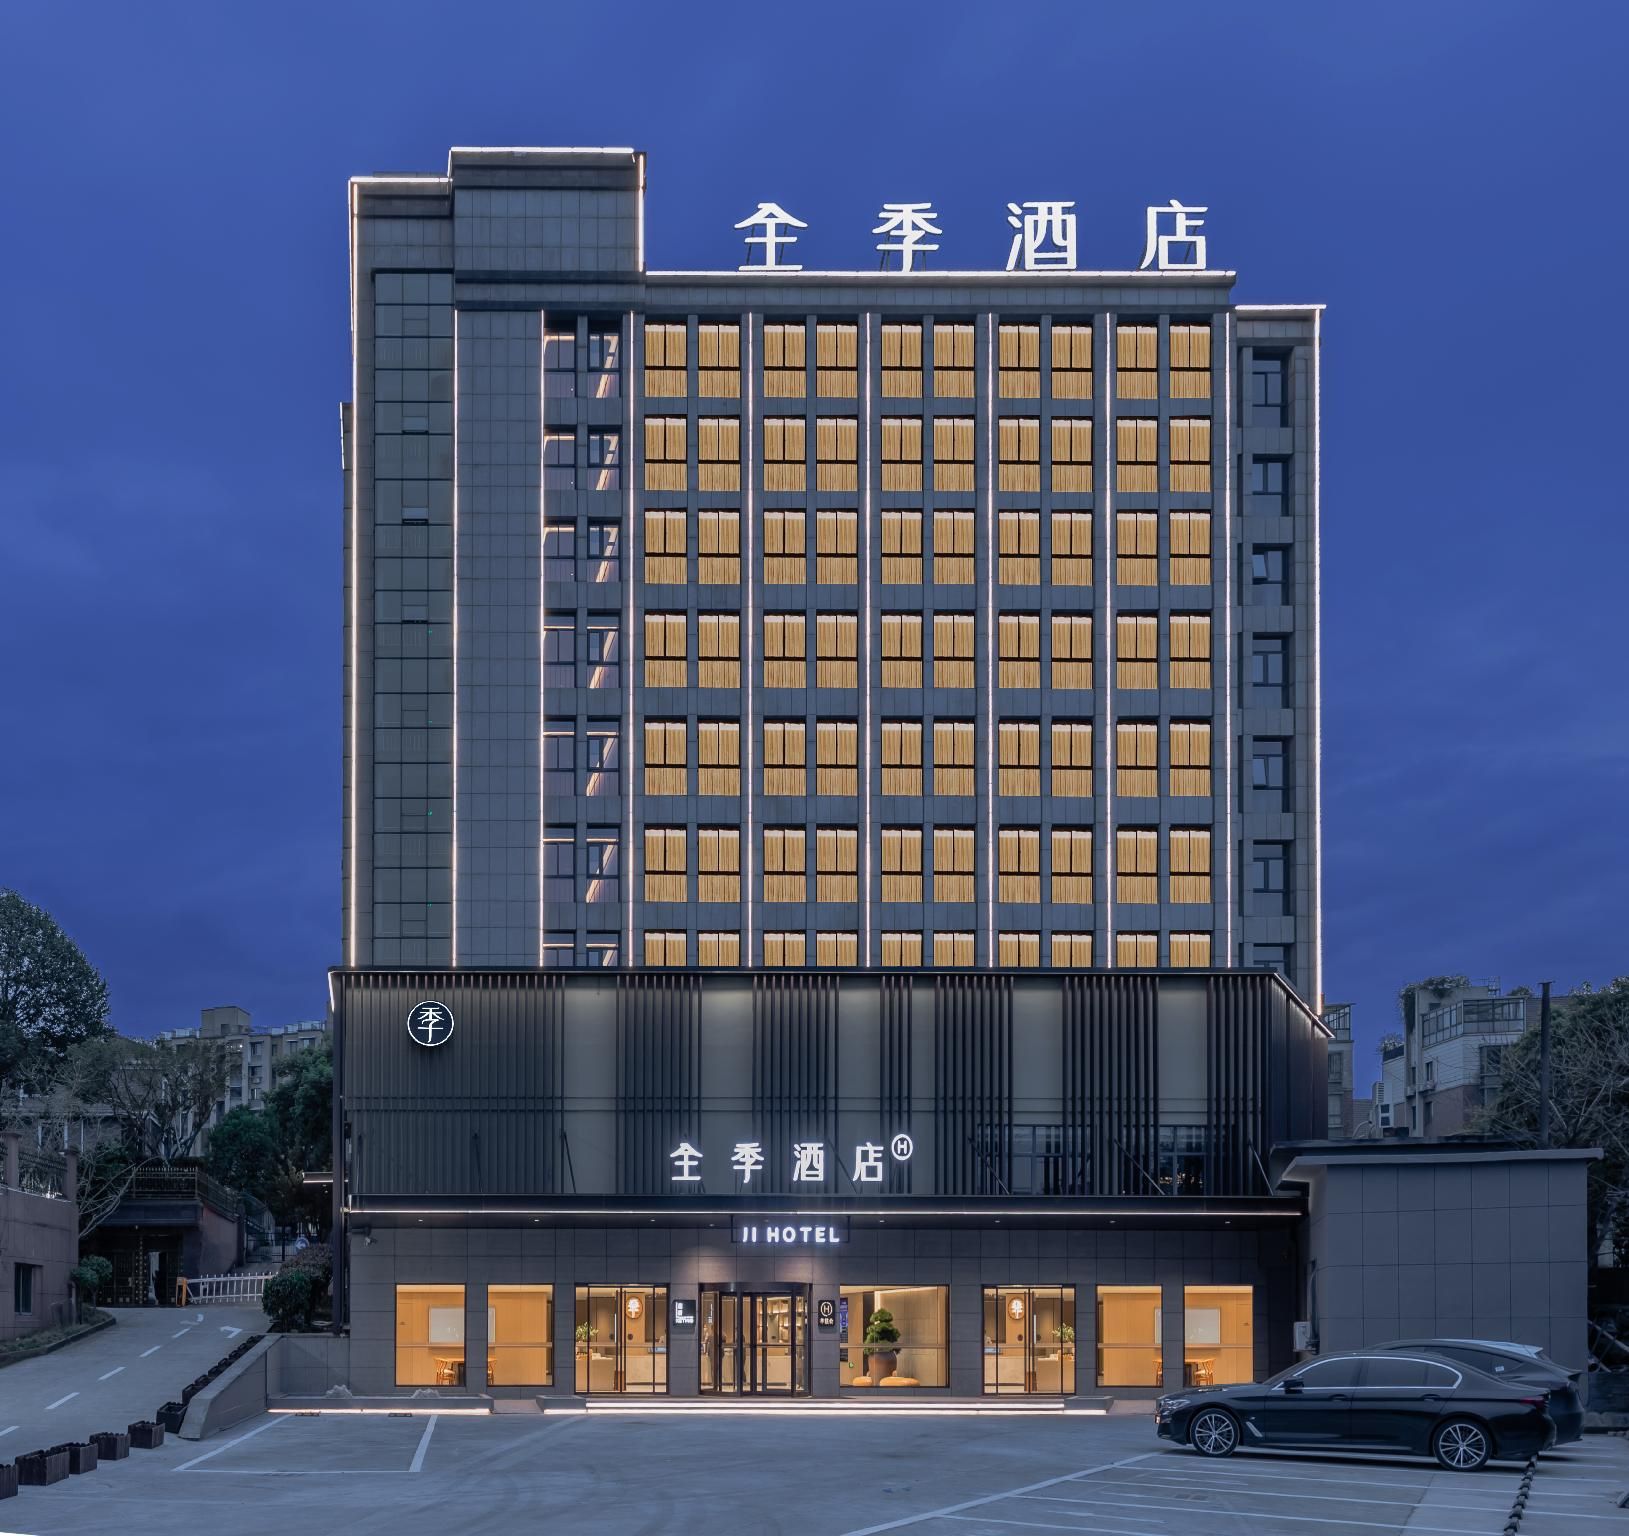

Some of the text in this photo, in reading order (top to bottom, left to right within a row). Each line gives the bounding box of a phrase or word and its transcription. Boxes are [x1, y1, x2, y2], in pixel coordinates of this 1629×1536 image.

[734, 199, 1209, 273] 全季酒店
[417, 1006, 445, 1043] 季
[669, 1141, 884, 1184] 全季酒店
[742, 1226, 840, 1243] JI HOTEL
